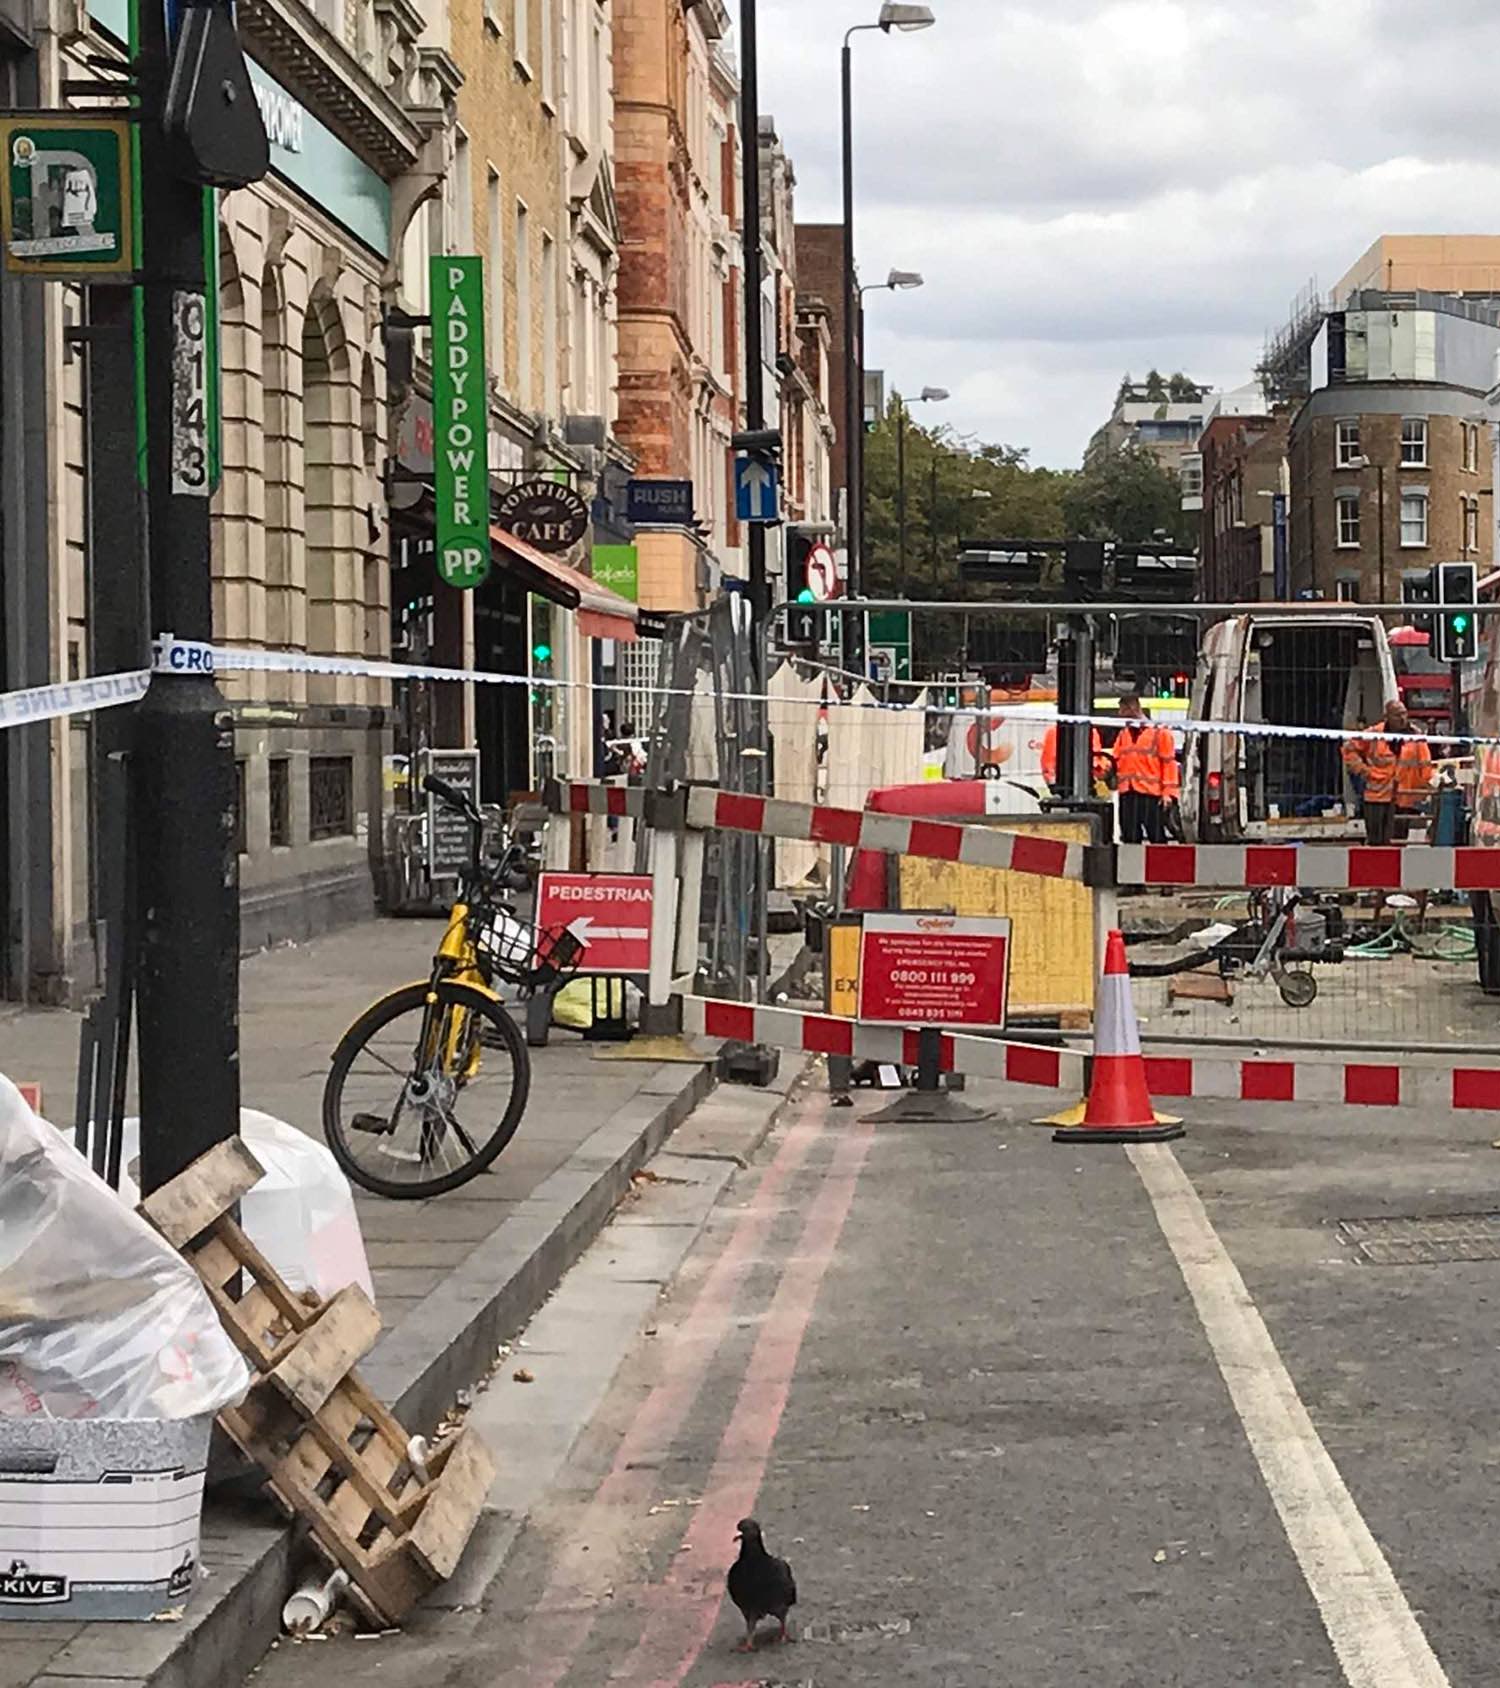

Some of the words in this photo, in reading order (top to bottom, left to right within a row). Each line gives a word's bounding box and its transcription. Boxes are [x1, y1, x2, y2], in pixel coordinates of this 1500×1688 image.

[500, 484, 586, 518] POMPIDOU
[633, 488, 688, 505] RUSH
[890, 970, 928, 984] 0800
[930, 971, 947, 984] 111
